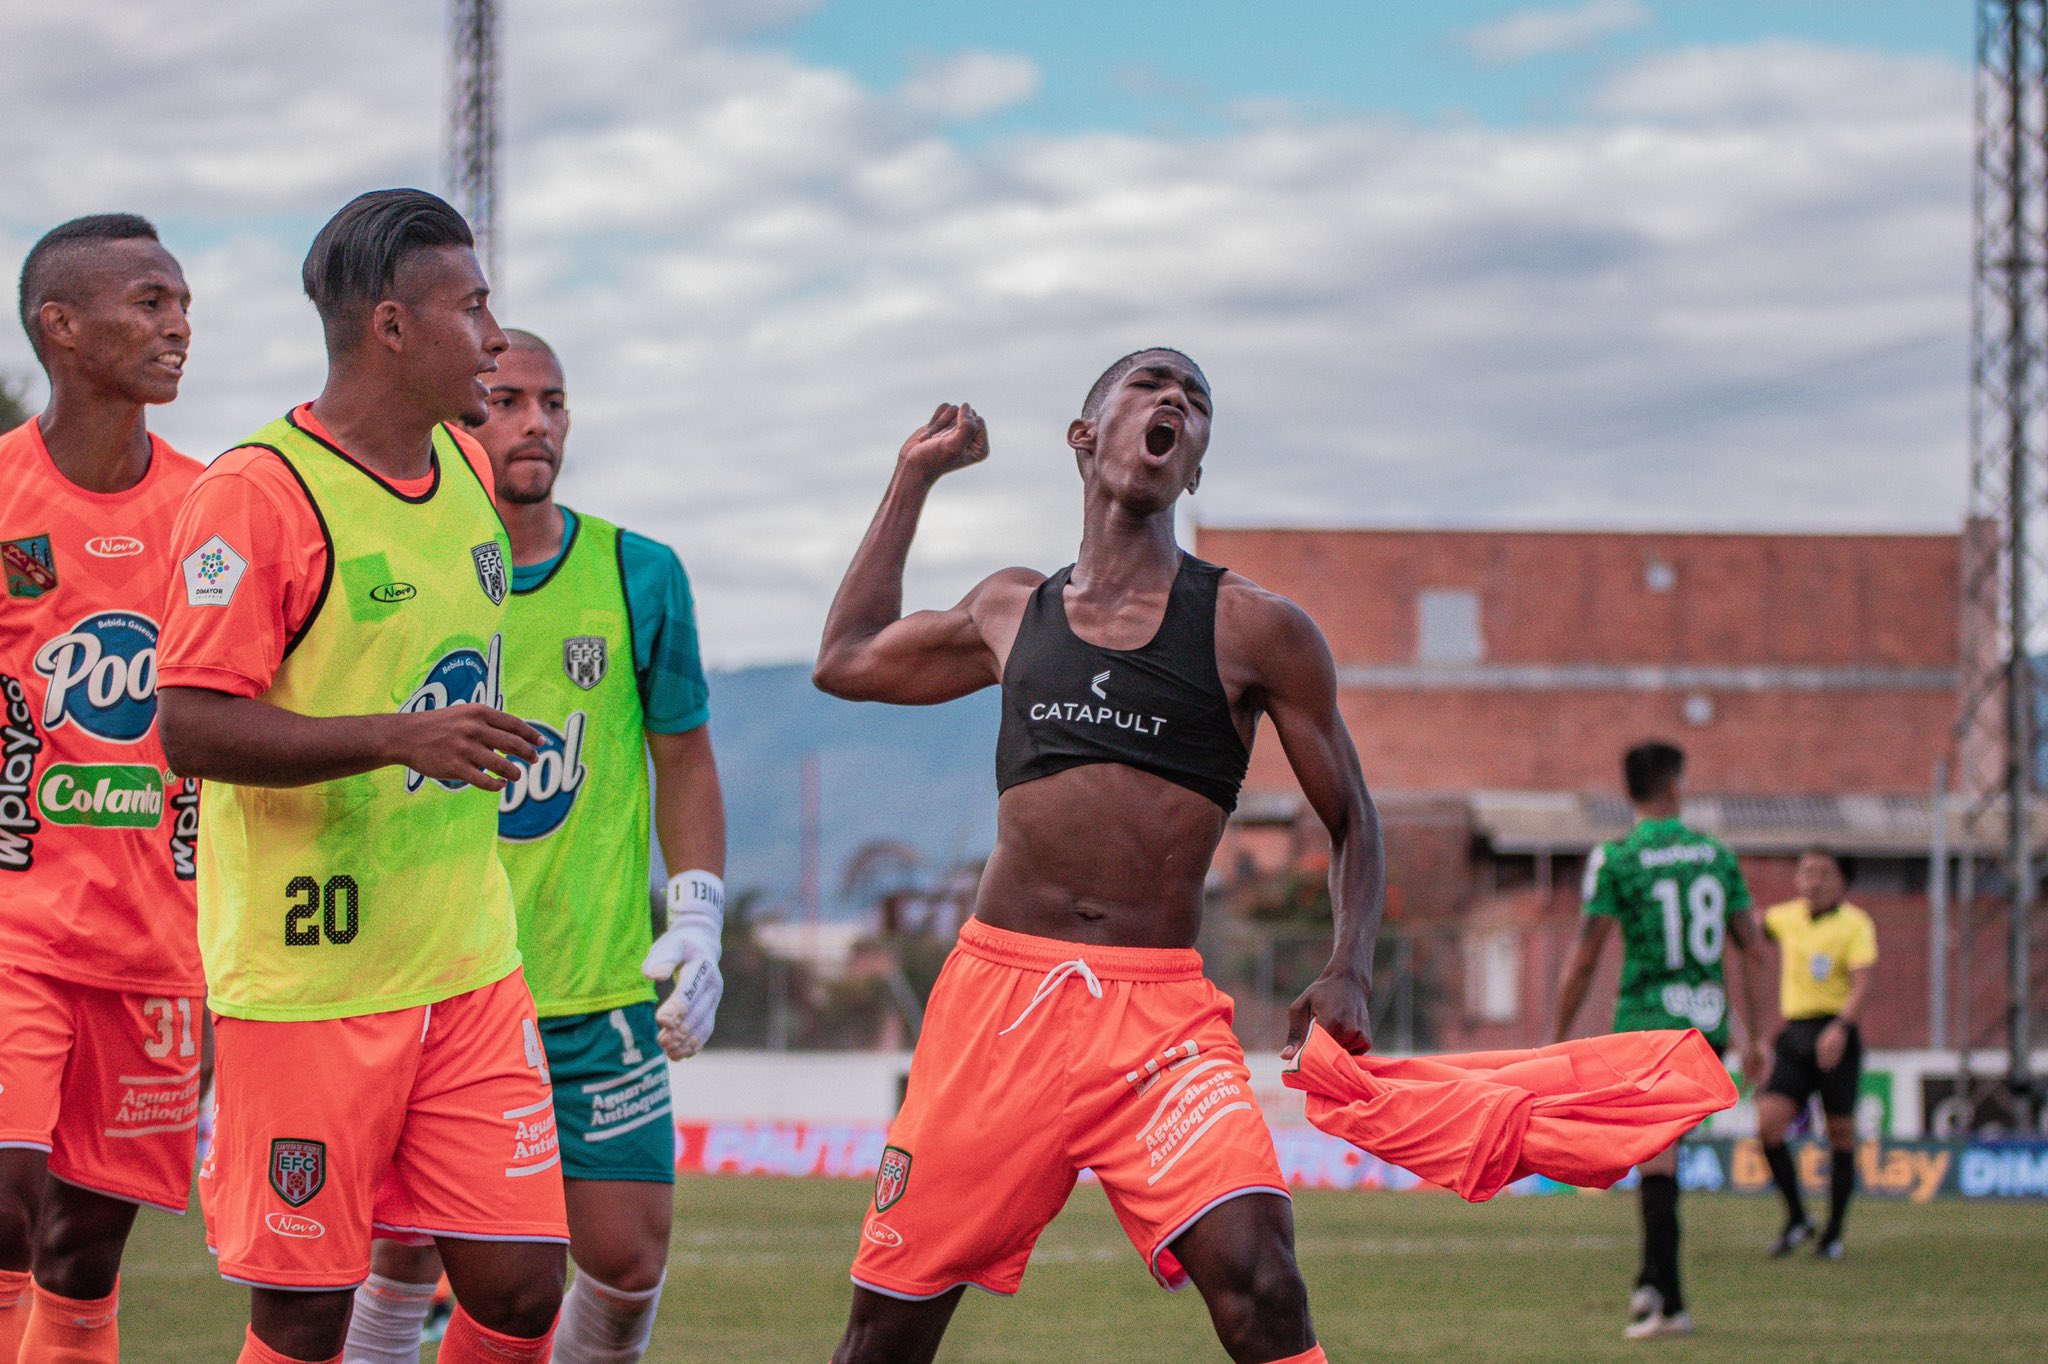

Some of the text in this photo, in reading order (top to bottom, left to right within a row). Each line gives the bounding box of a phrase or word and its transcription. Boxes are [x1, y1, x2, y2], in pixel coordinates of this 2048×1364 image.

[480, 556, 503, 573] EFC
[97, 618, 126, 629] Bebida
[36, 632, 158, 725] Poo
[442, 658, 464, 675] Bebida
[571, 649, 600, 661] EFC
[1030, 702, 1168, 736] CATAPULT
[499, 712, 582, 813] ool
[41, 774, 162, 815] Colanta
[285, 874, 359, 946] 20
[1652, 873, 1727, 969] 18
[143, 997, 195, 1058] 31
[522, 1018, 550, 1085] 4
[609, 1009, 643, 1066] 1
[1145, 1071, 1234, 1152] Aguardiente
[1150, 1081, 1241, 1169] Antioqueño
[281, 1156, 315, 1172] EFC
[883, 1163, 902, 1181] EFC
[277, 1216, 317, 1232] Novo
